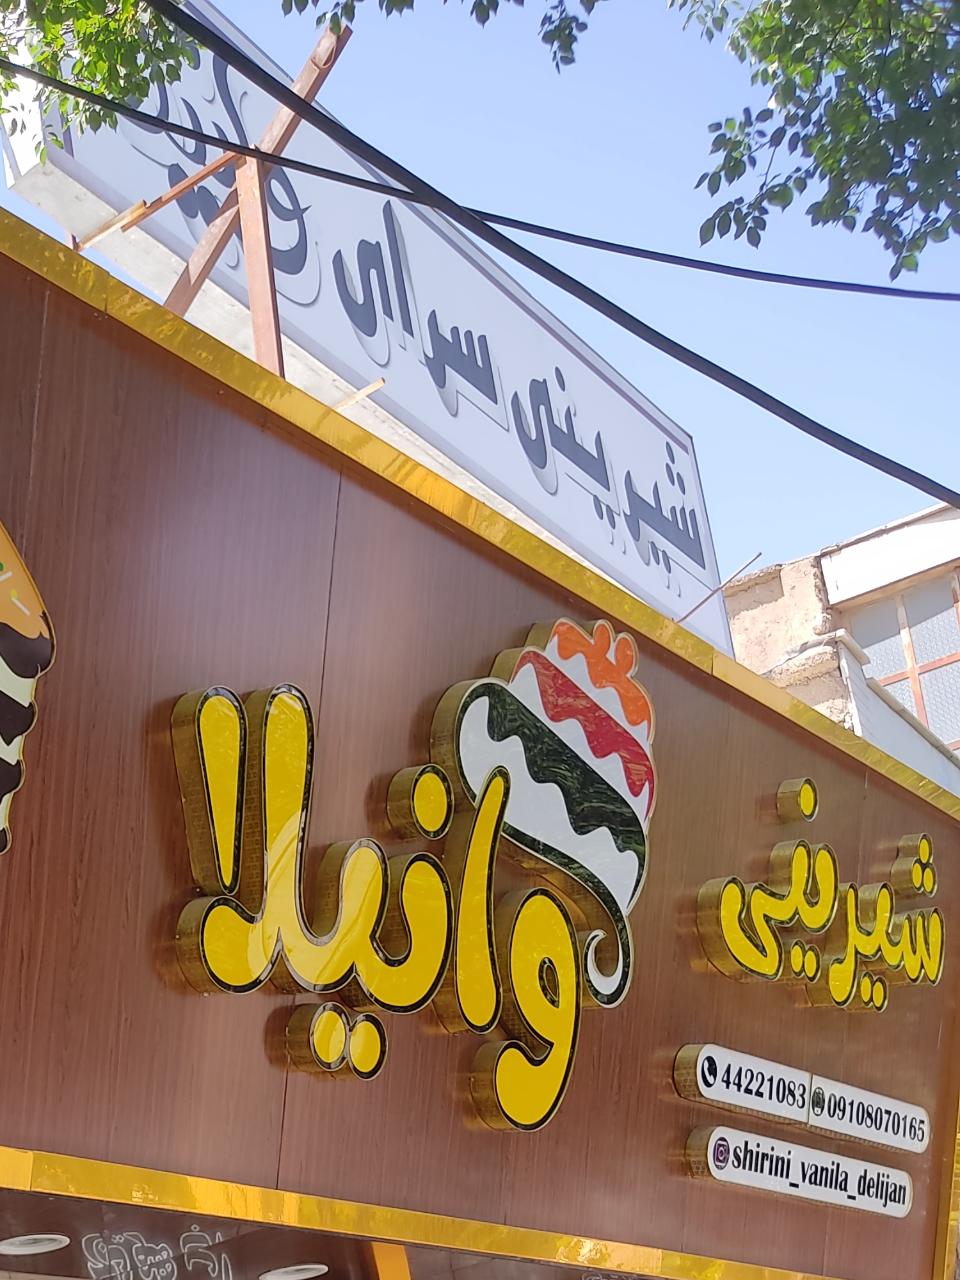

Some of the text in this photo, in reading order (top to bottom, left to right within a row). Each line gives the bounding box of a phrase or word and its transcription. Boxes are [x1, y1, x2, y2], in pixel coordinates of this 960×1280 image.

[332, 200, 707, 571] شیرینی سرای
[198, 684, 945, 1130] شیرینی وانیلا
[720, 1063, 926, 1142] 44221083 09108070165
[731, 1141, 908, 1208] shirini_vanila_delijan
